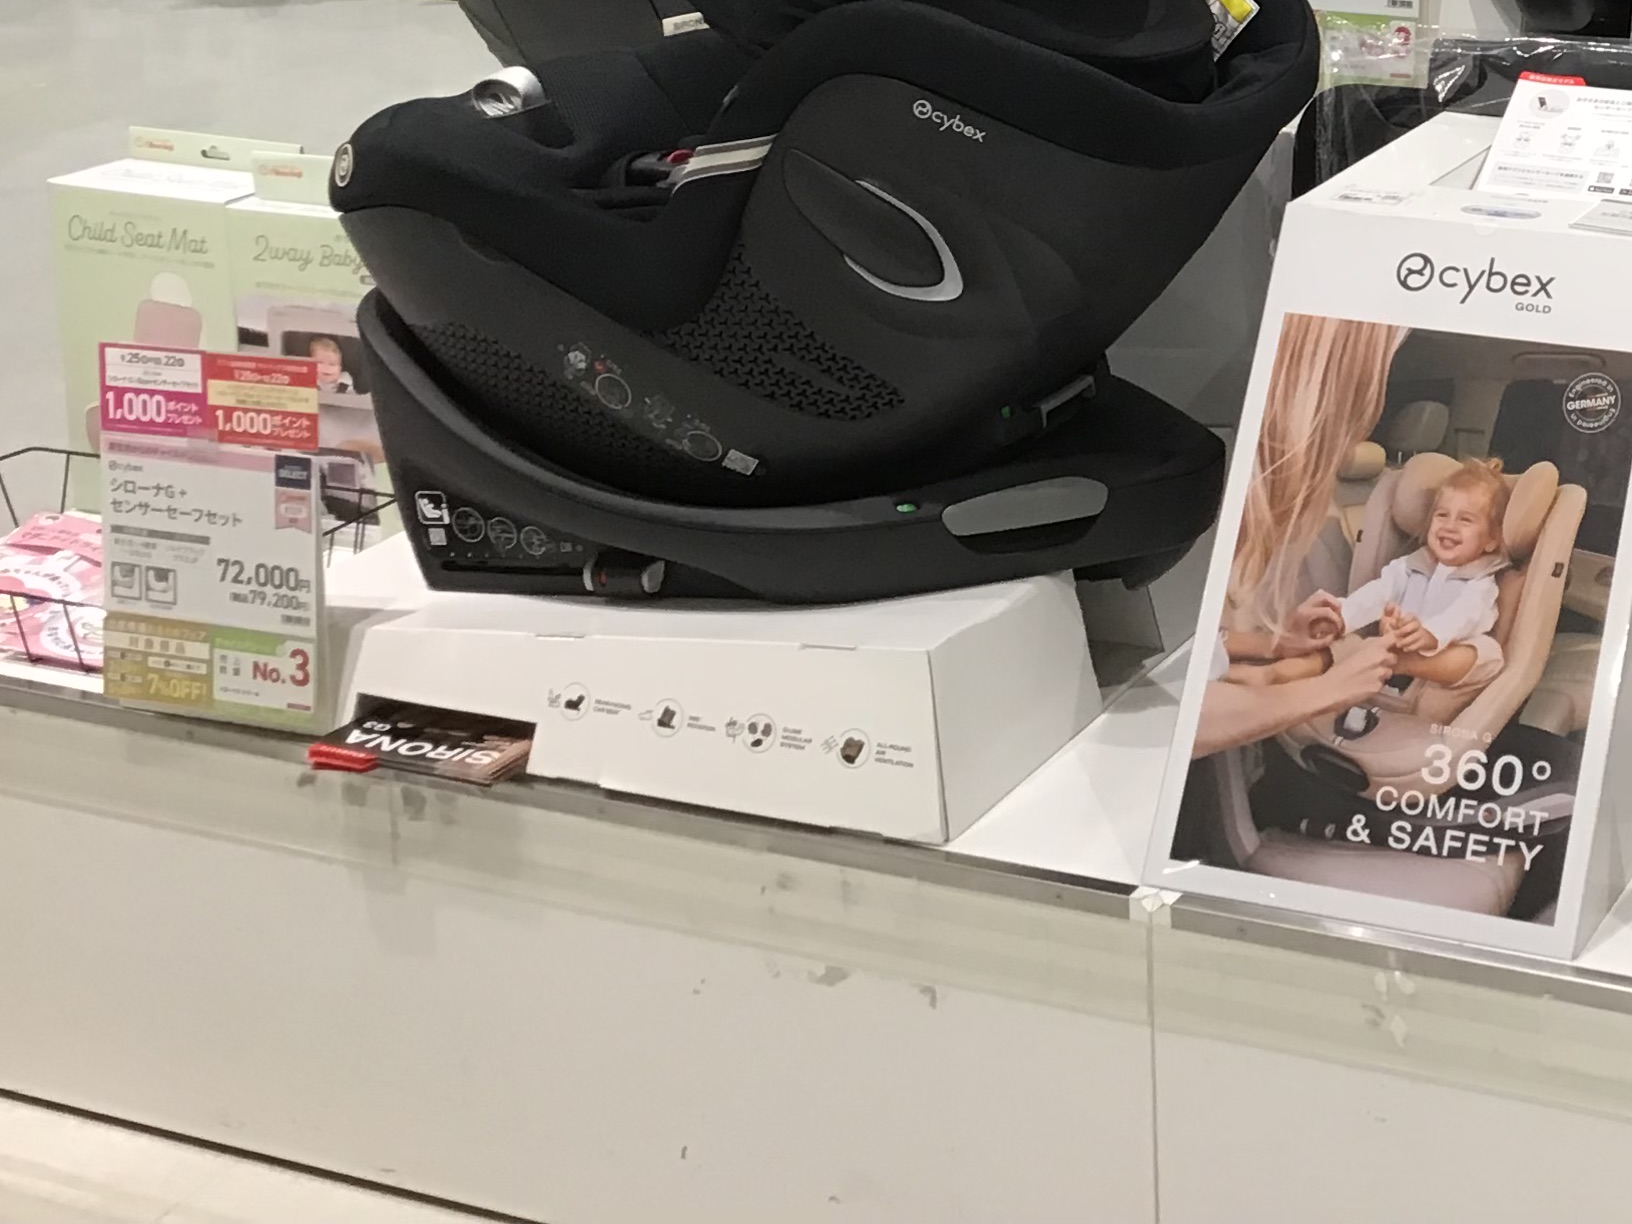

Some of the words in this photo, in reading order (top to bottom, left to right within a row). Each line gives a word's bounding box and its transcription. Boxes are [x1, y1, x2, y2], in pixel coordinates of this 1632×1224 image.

[931, 111, 987, 143] cybex
[67, 214, 117, 243] Child
[119, 220, 164, 249] Seat
[167, 226, 209, 256] Mat
[253, 235, 314, 272] 2way
[1438, 257, 1556, 305] cybex
[1515, 302, 1552, 315] GOLD
[106, 390, 166, 423] 1,000
[1567, 395, 1616, 410] GERMANY
[215, 409, 272, 434] 1,000
[110, 498, 243, 526] センサーセーフセット
[216, 558, 311, 594] 72,000円
[345, 728, 501, 764] SIRONA
[1421, 744, 1551, 796] 360°
[1375, 786, 1549, 836] COMFORT
[1346, 814, 1371, 844] &
[1388, 821, 1544, 871] SAFETY
